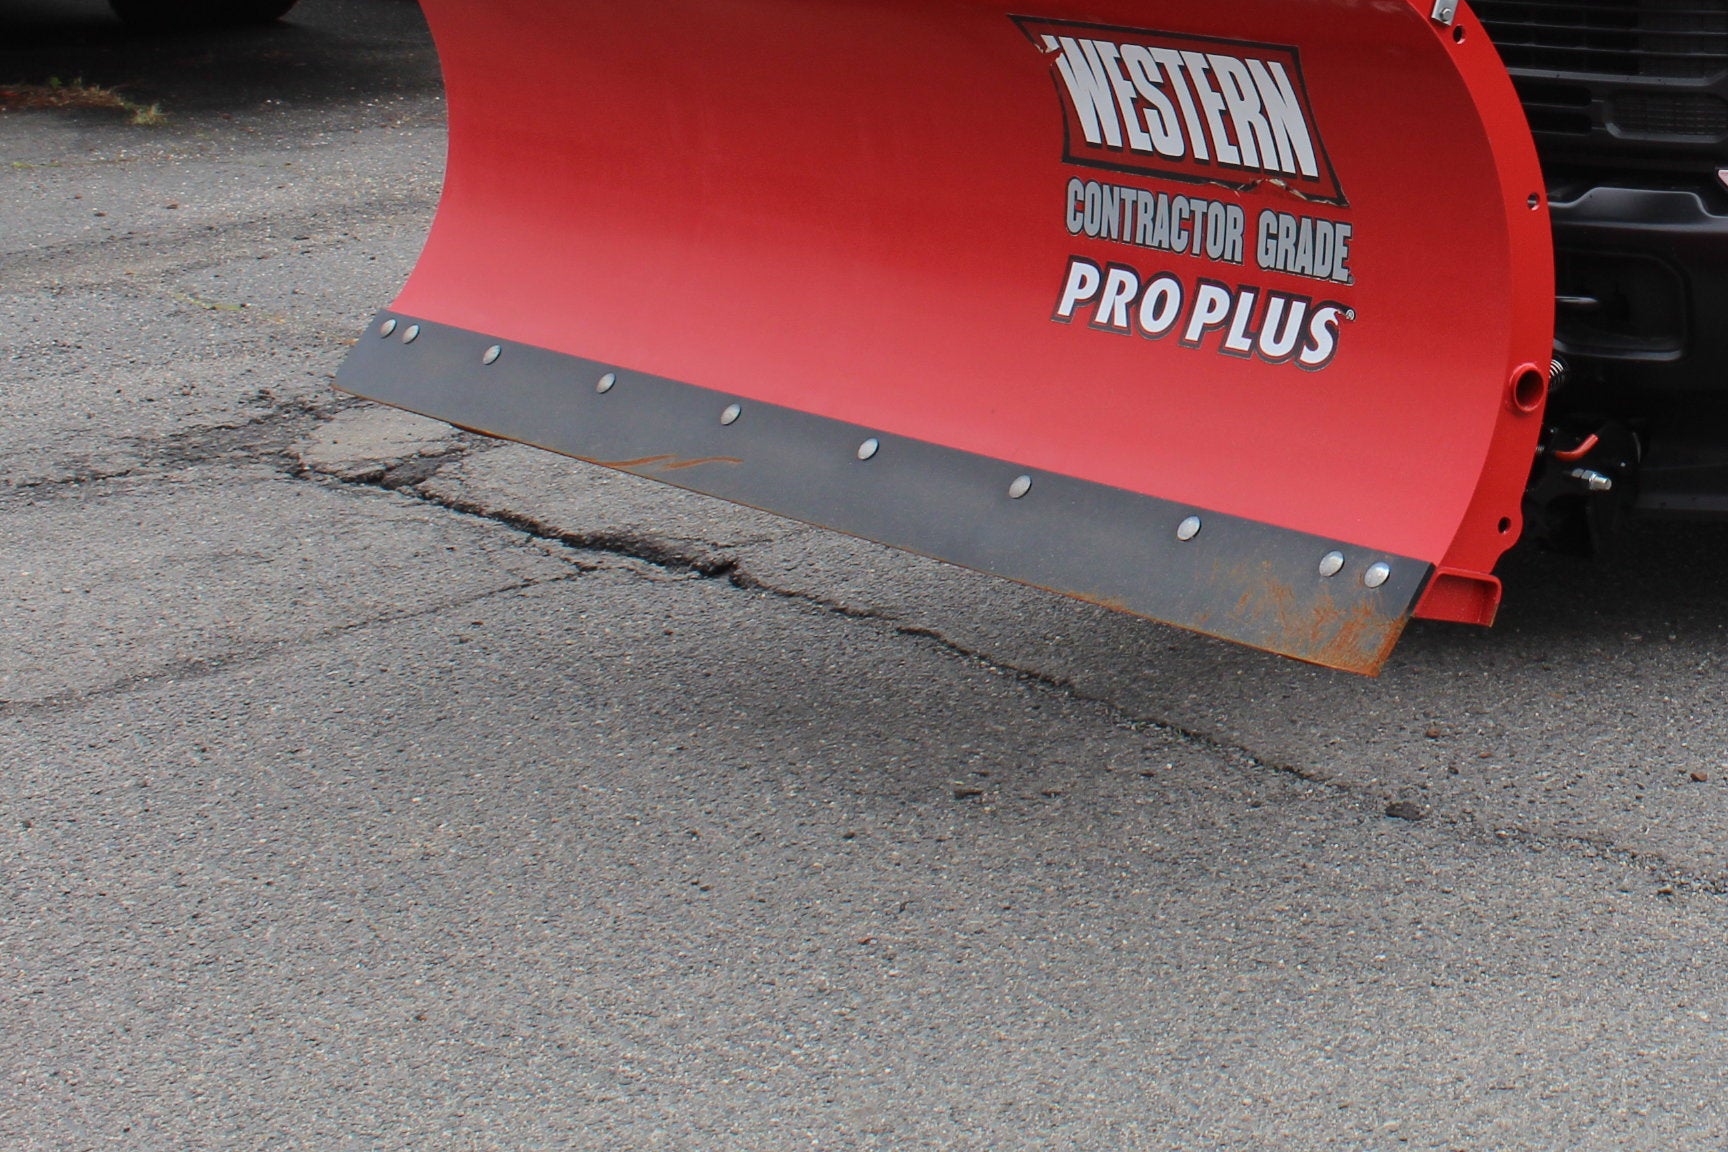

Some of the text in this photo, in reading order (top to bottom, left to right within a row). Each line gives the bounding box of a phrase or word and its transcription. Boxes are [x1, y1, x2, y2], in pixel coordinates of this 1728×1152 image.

[1040, 33, 1319, 179] WESTERN
[1066, 176, 1353, 285] CONTRACTOR GRADE
